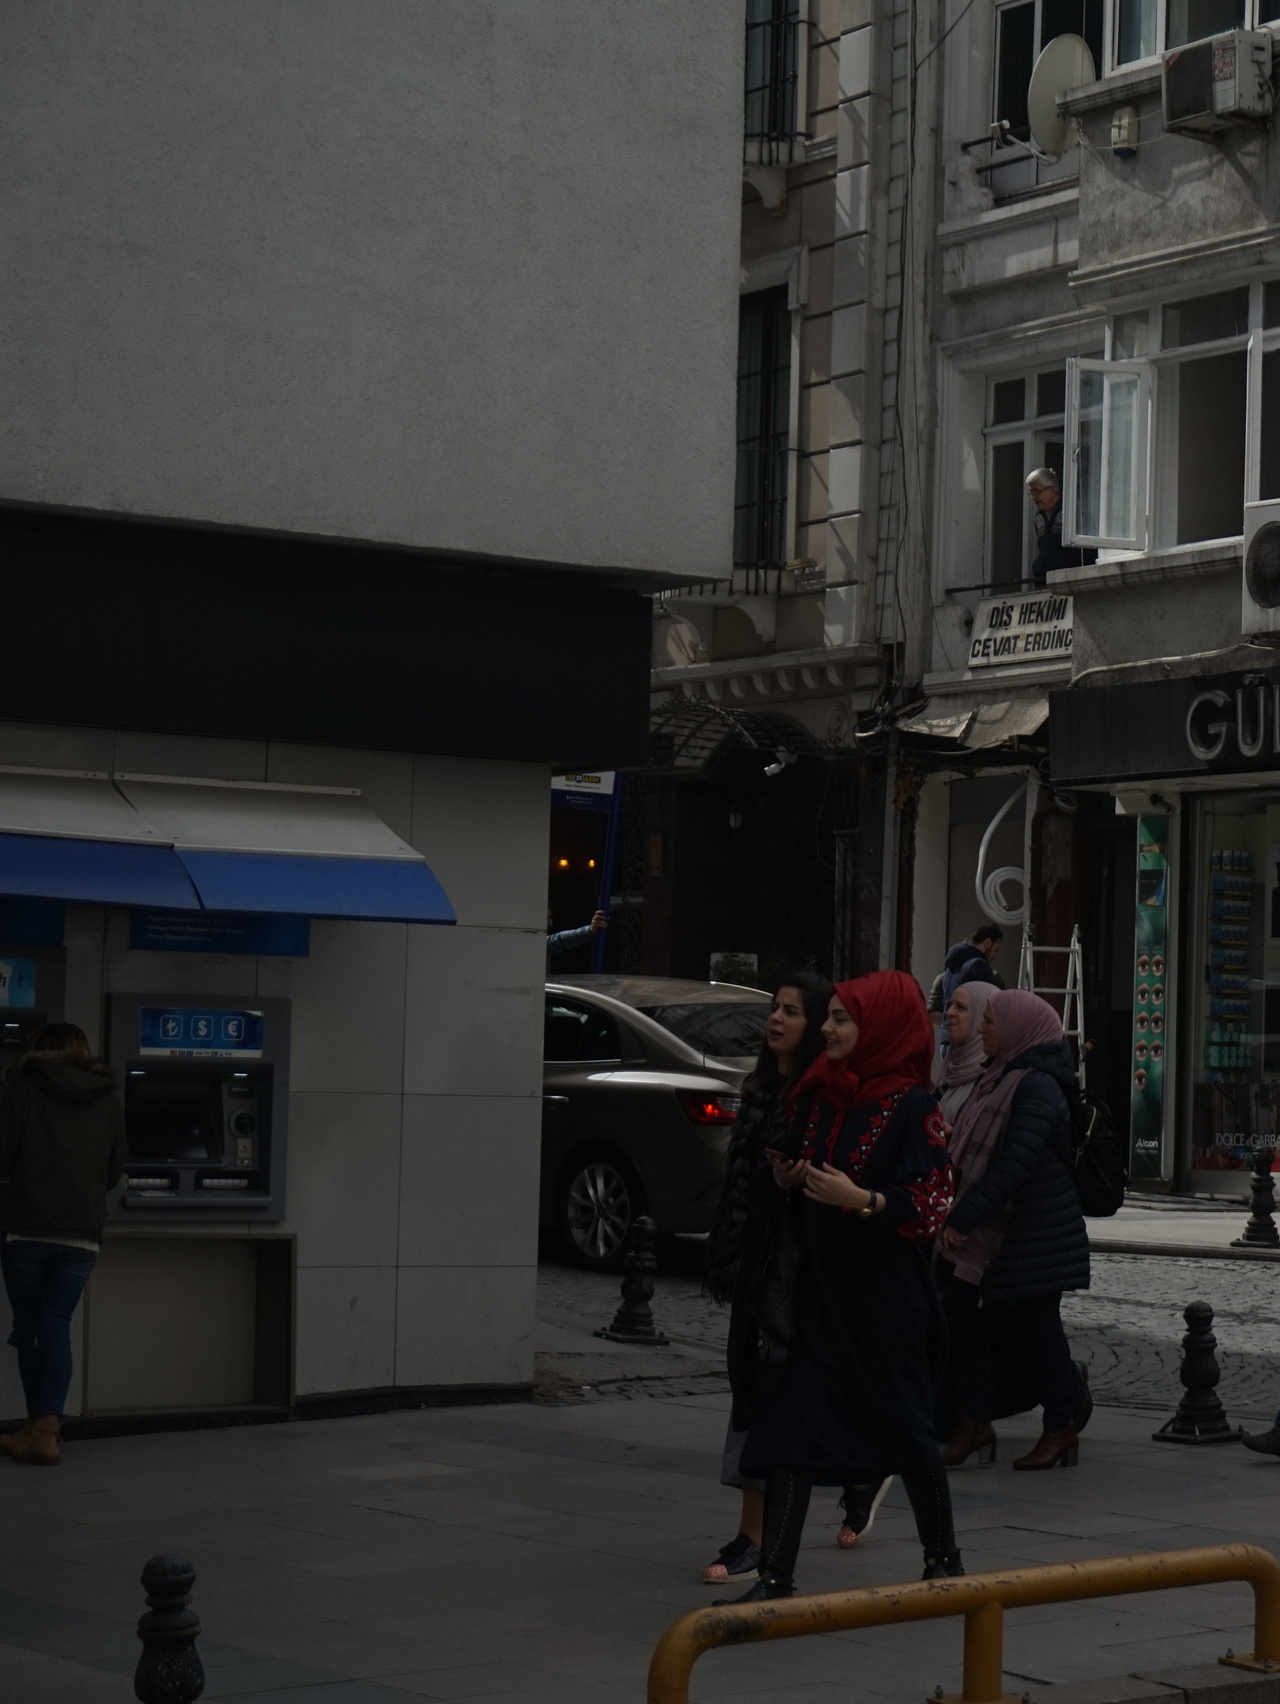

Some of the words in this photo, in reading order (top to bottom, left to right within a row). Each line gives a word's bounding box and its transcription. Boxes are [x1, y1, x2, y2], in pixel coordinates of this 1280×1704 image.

[989, 601, 1014, 630] DİŞ
[971, 635, 1020, 658] CEVAT
[1023, 625, 1073, 653] ERDİNÇ
